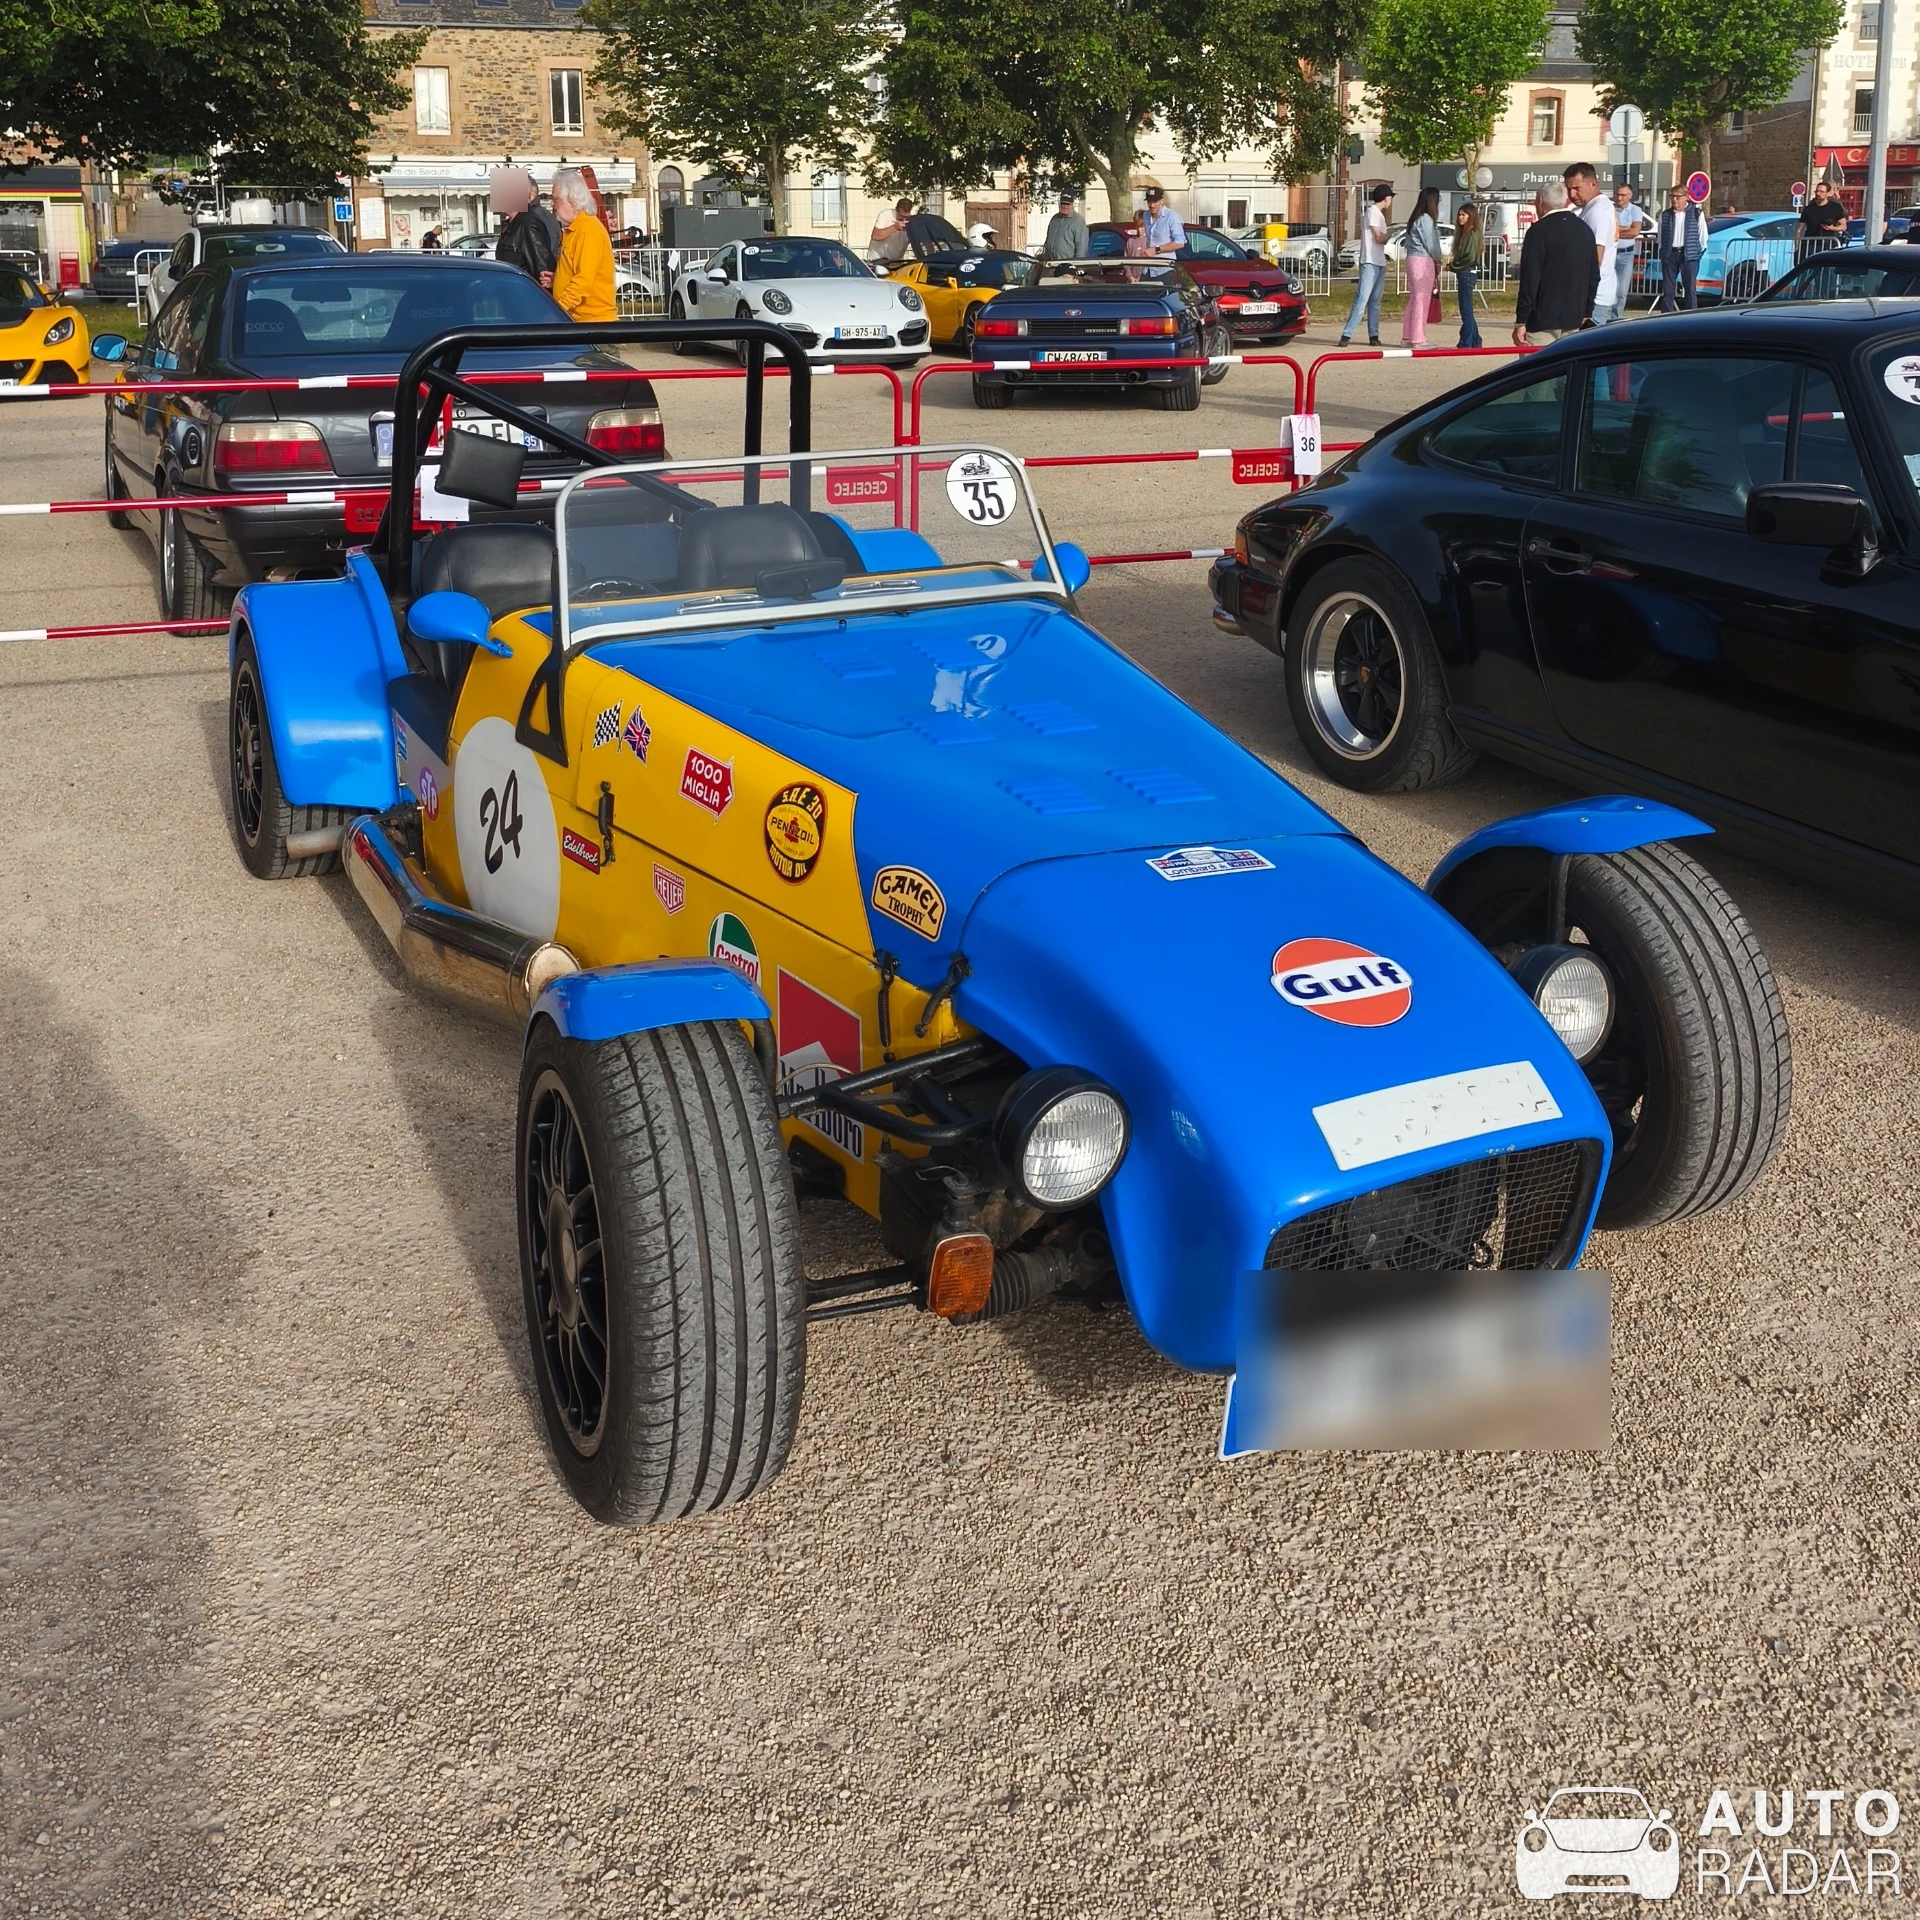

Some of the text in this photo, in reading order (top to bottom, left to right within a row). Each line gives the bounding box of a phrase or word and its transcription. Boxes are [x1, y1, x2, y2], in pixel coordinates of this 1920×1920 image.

[1834, 54, 1875, 68] HOTE
[475, 163, 535, 177] JE
[1846, 148, 1908, 163] CAE
[1603, 171, 1613, 182] la
[245, 321, 284, 333] parco
[523, 435, 538, 448] 35
[1301, 437, 1315, 452] 36
[962, 480, 1005, 521] 35
[691, 756, 723, 785] 1000
[421, 771, 438, 816] STP
[683, 775, 720, 808] MIGLIA
[479, 769, 524, 875] 24
[806, 795, 823, 820] 30
[770, 816, 815, 845] PENNZOIL
[563, 835, 599, 866] Edelbrock
[769, 843, 793, 878] MOTOR
[795, 862, 807, 878] OIL
[1163, 864, 1217, 876] Lombard
[657, 874, 683, 908] HEUER
[879, 875, 939, 925] CAMEL
[888, 895, 925, 926] TROPHY
[715, 943, 759, 982] Castrol
[1283, 961, 1403, 1000] Gulf
[779, 1059, 862, 1158] Mlboro
